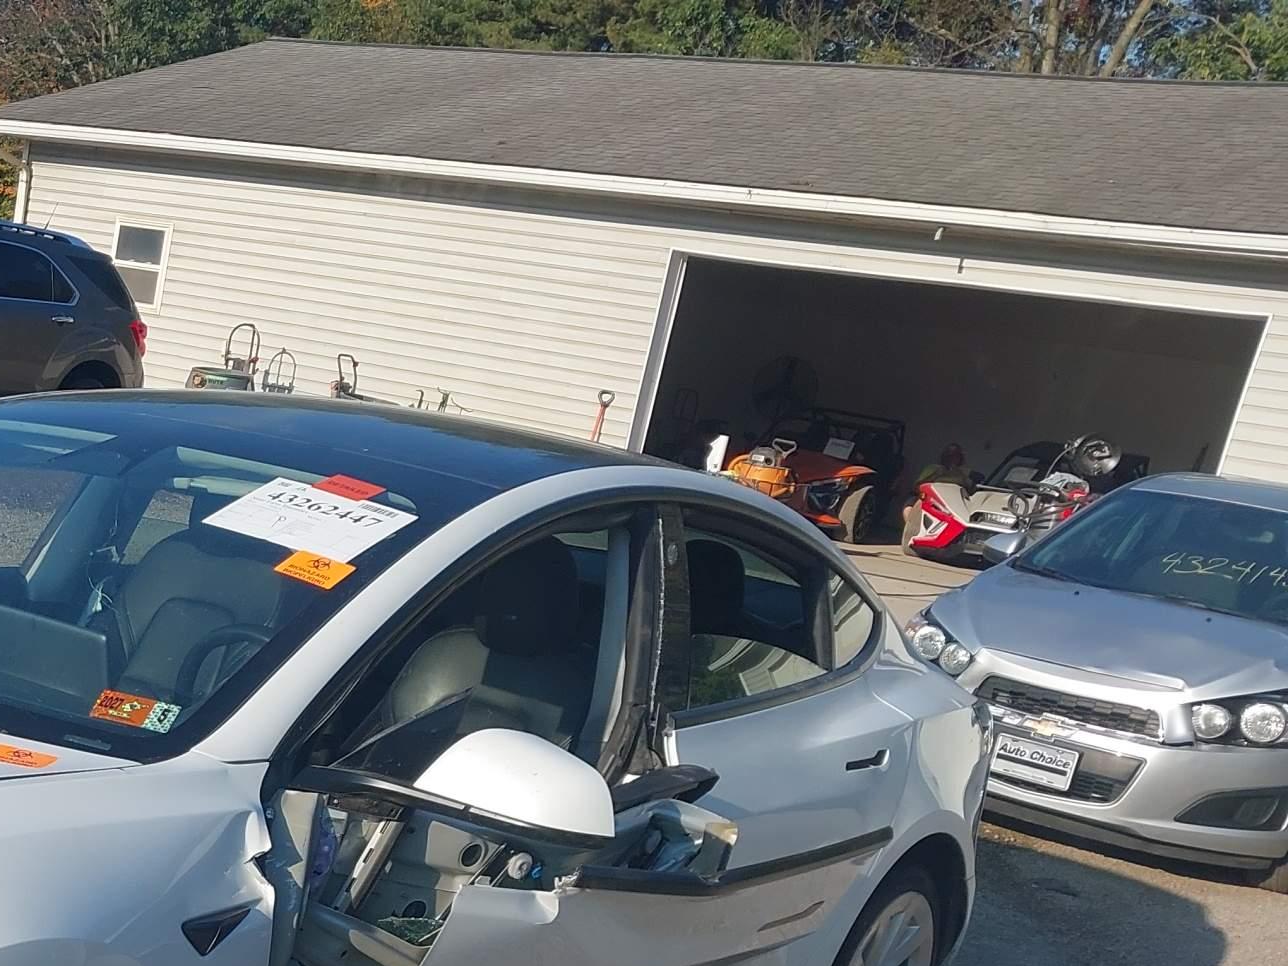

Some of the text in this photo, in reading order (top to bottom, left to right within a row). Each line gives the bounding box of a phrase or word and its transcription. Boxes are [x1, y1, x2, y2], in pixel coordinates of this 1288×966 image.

[267, 491, 384, 527] 43262447
[1162, 552, 1288, 587] 432414
[999, 742, 1071, 769] Auto Choice
